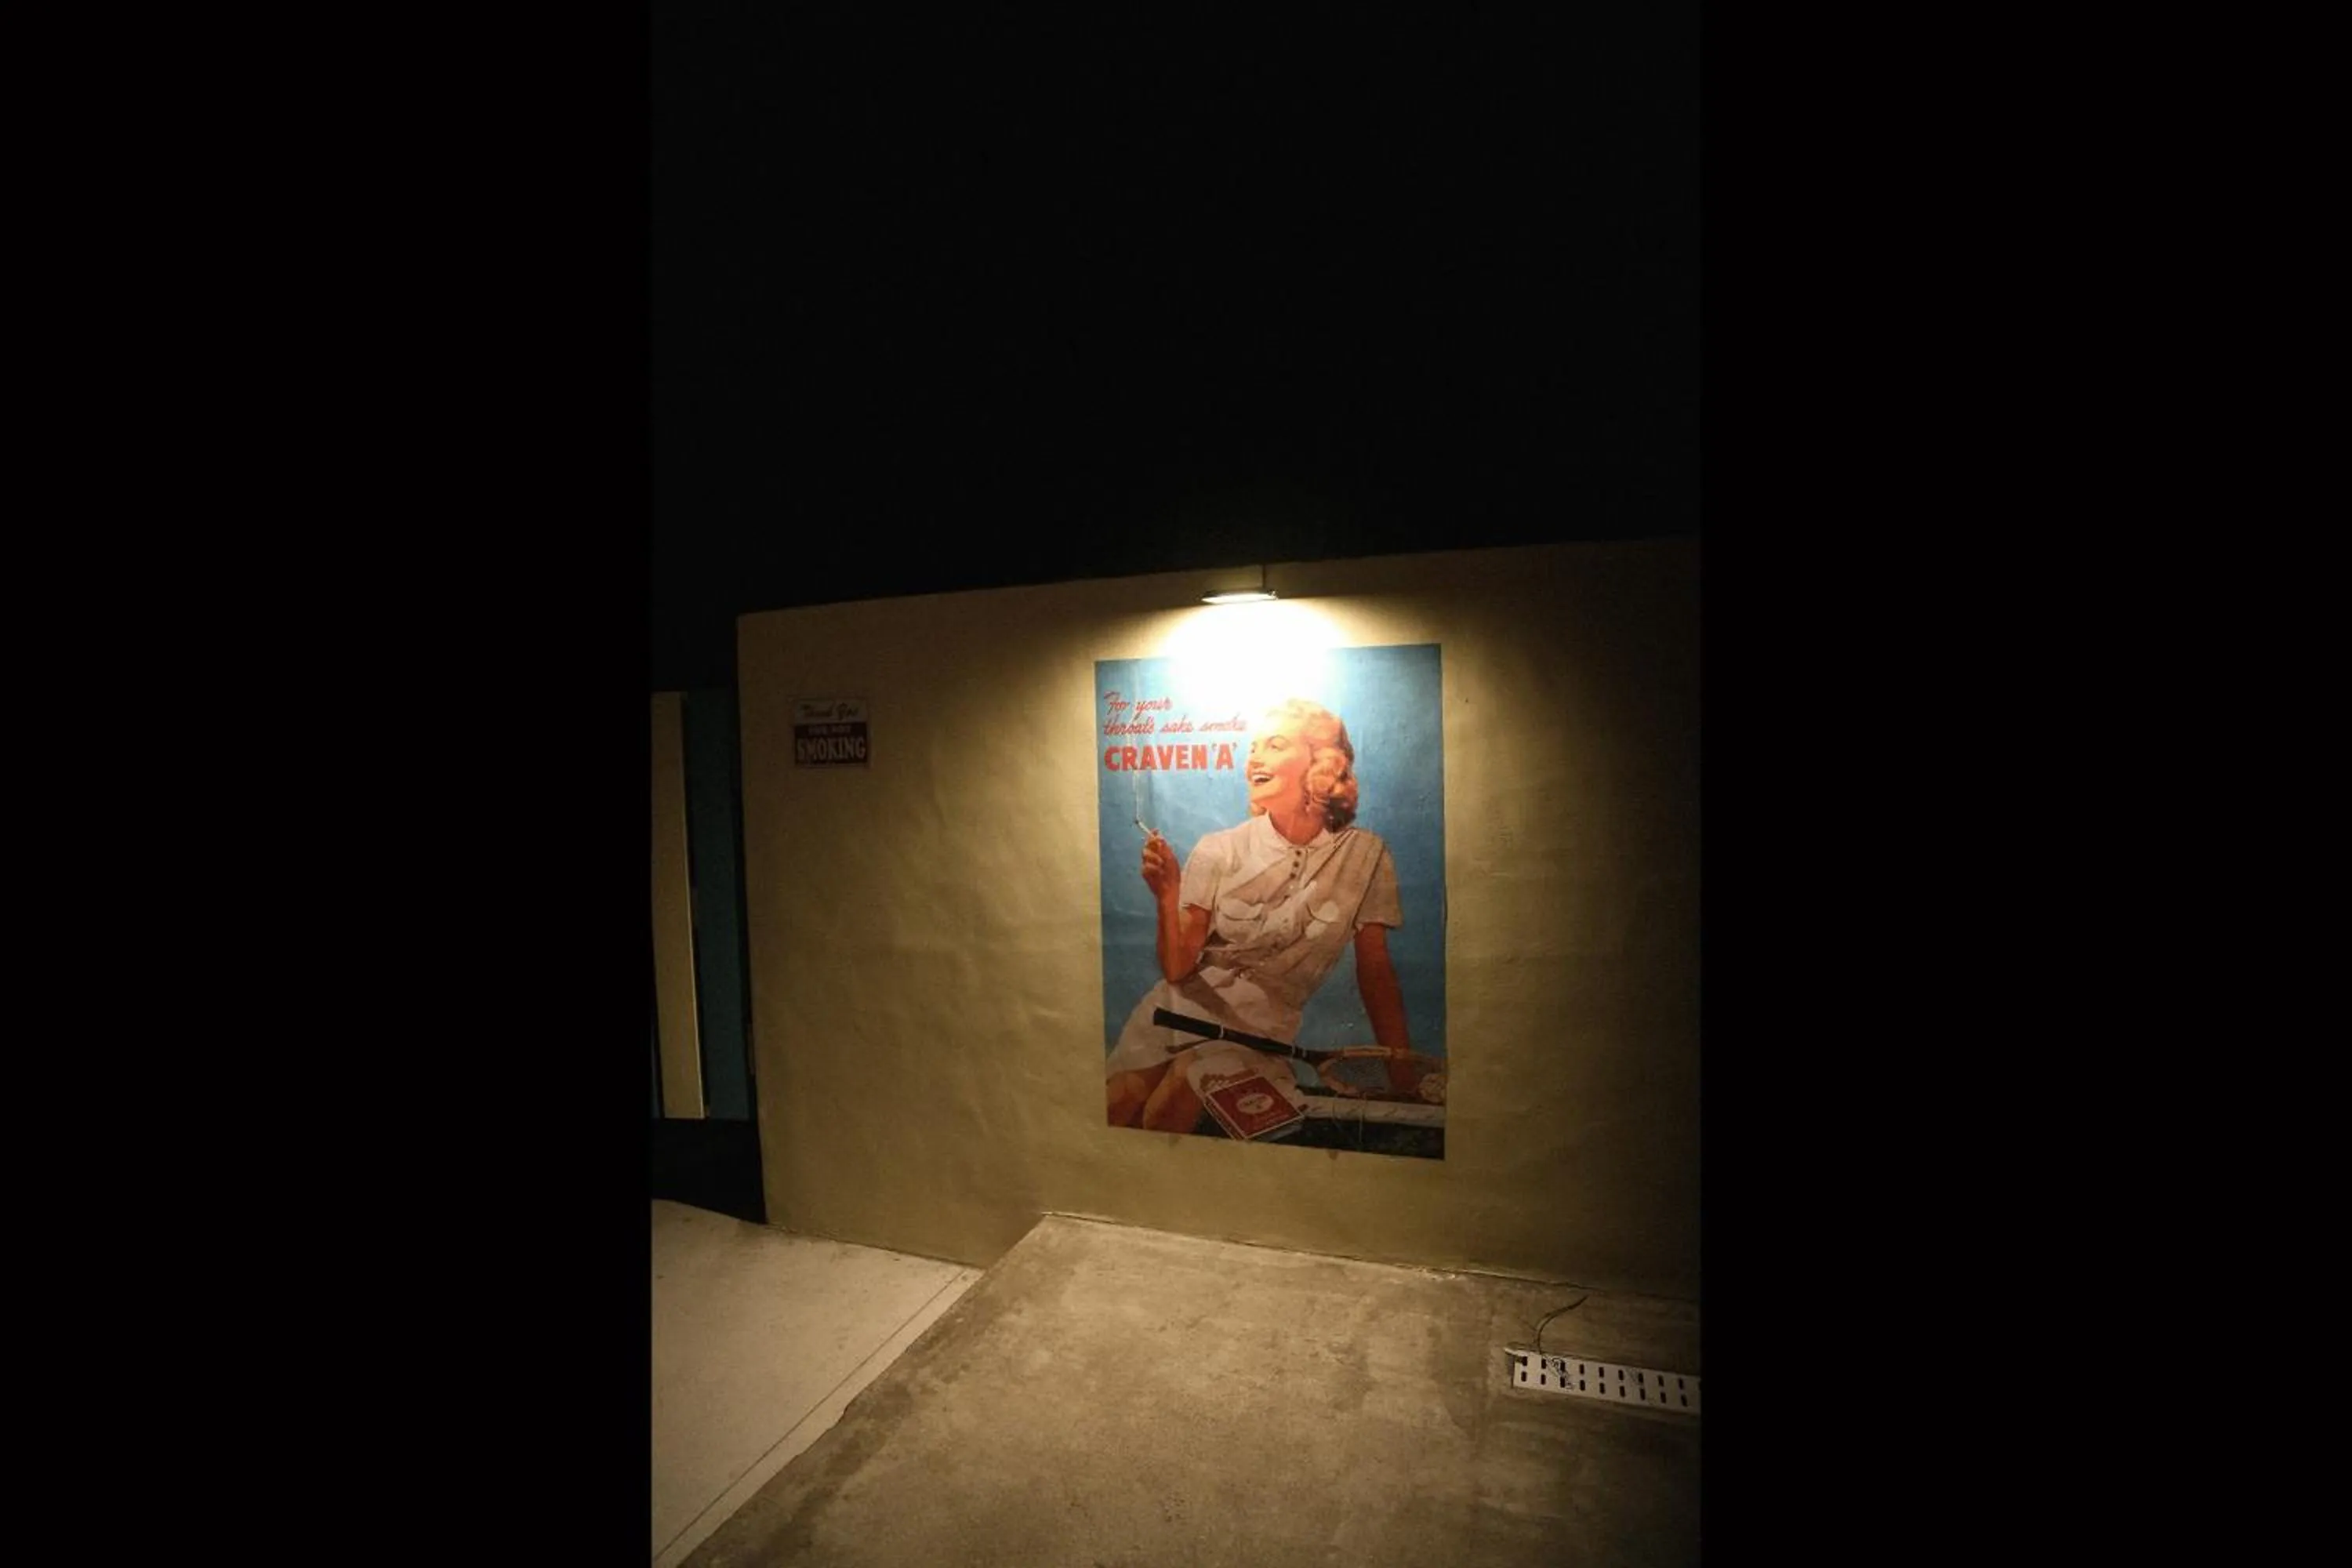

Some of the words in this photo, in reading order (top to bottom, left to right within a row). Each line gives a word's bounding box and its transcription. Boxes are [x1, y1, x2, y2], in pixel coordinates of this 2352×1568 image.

[1133, 697, 1172, 720] your
[1160, 714, 1194, 733] sake
[1200, 713, 1247, 731] smoke
[797, 736, 866, 760] SMOKING
[1104, 744, 1207, 771] CRAVEN
